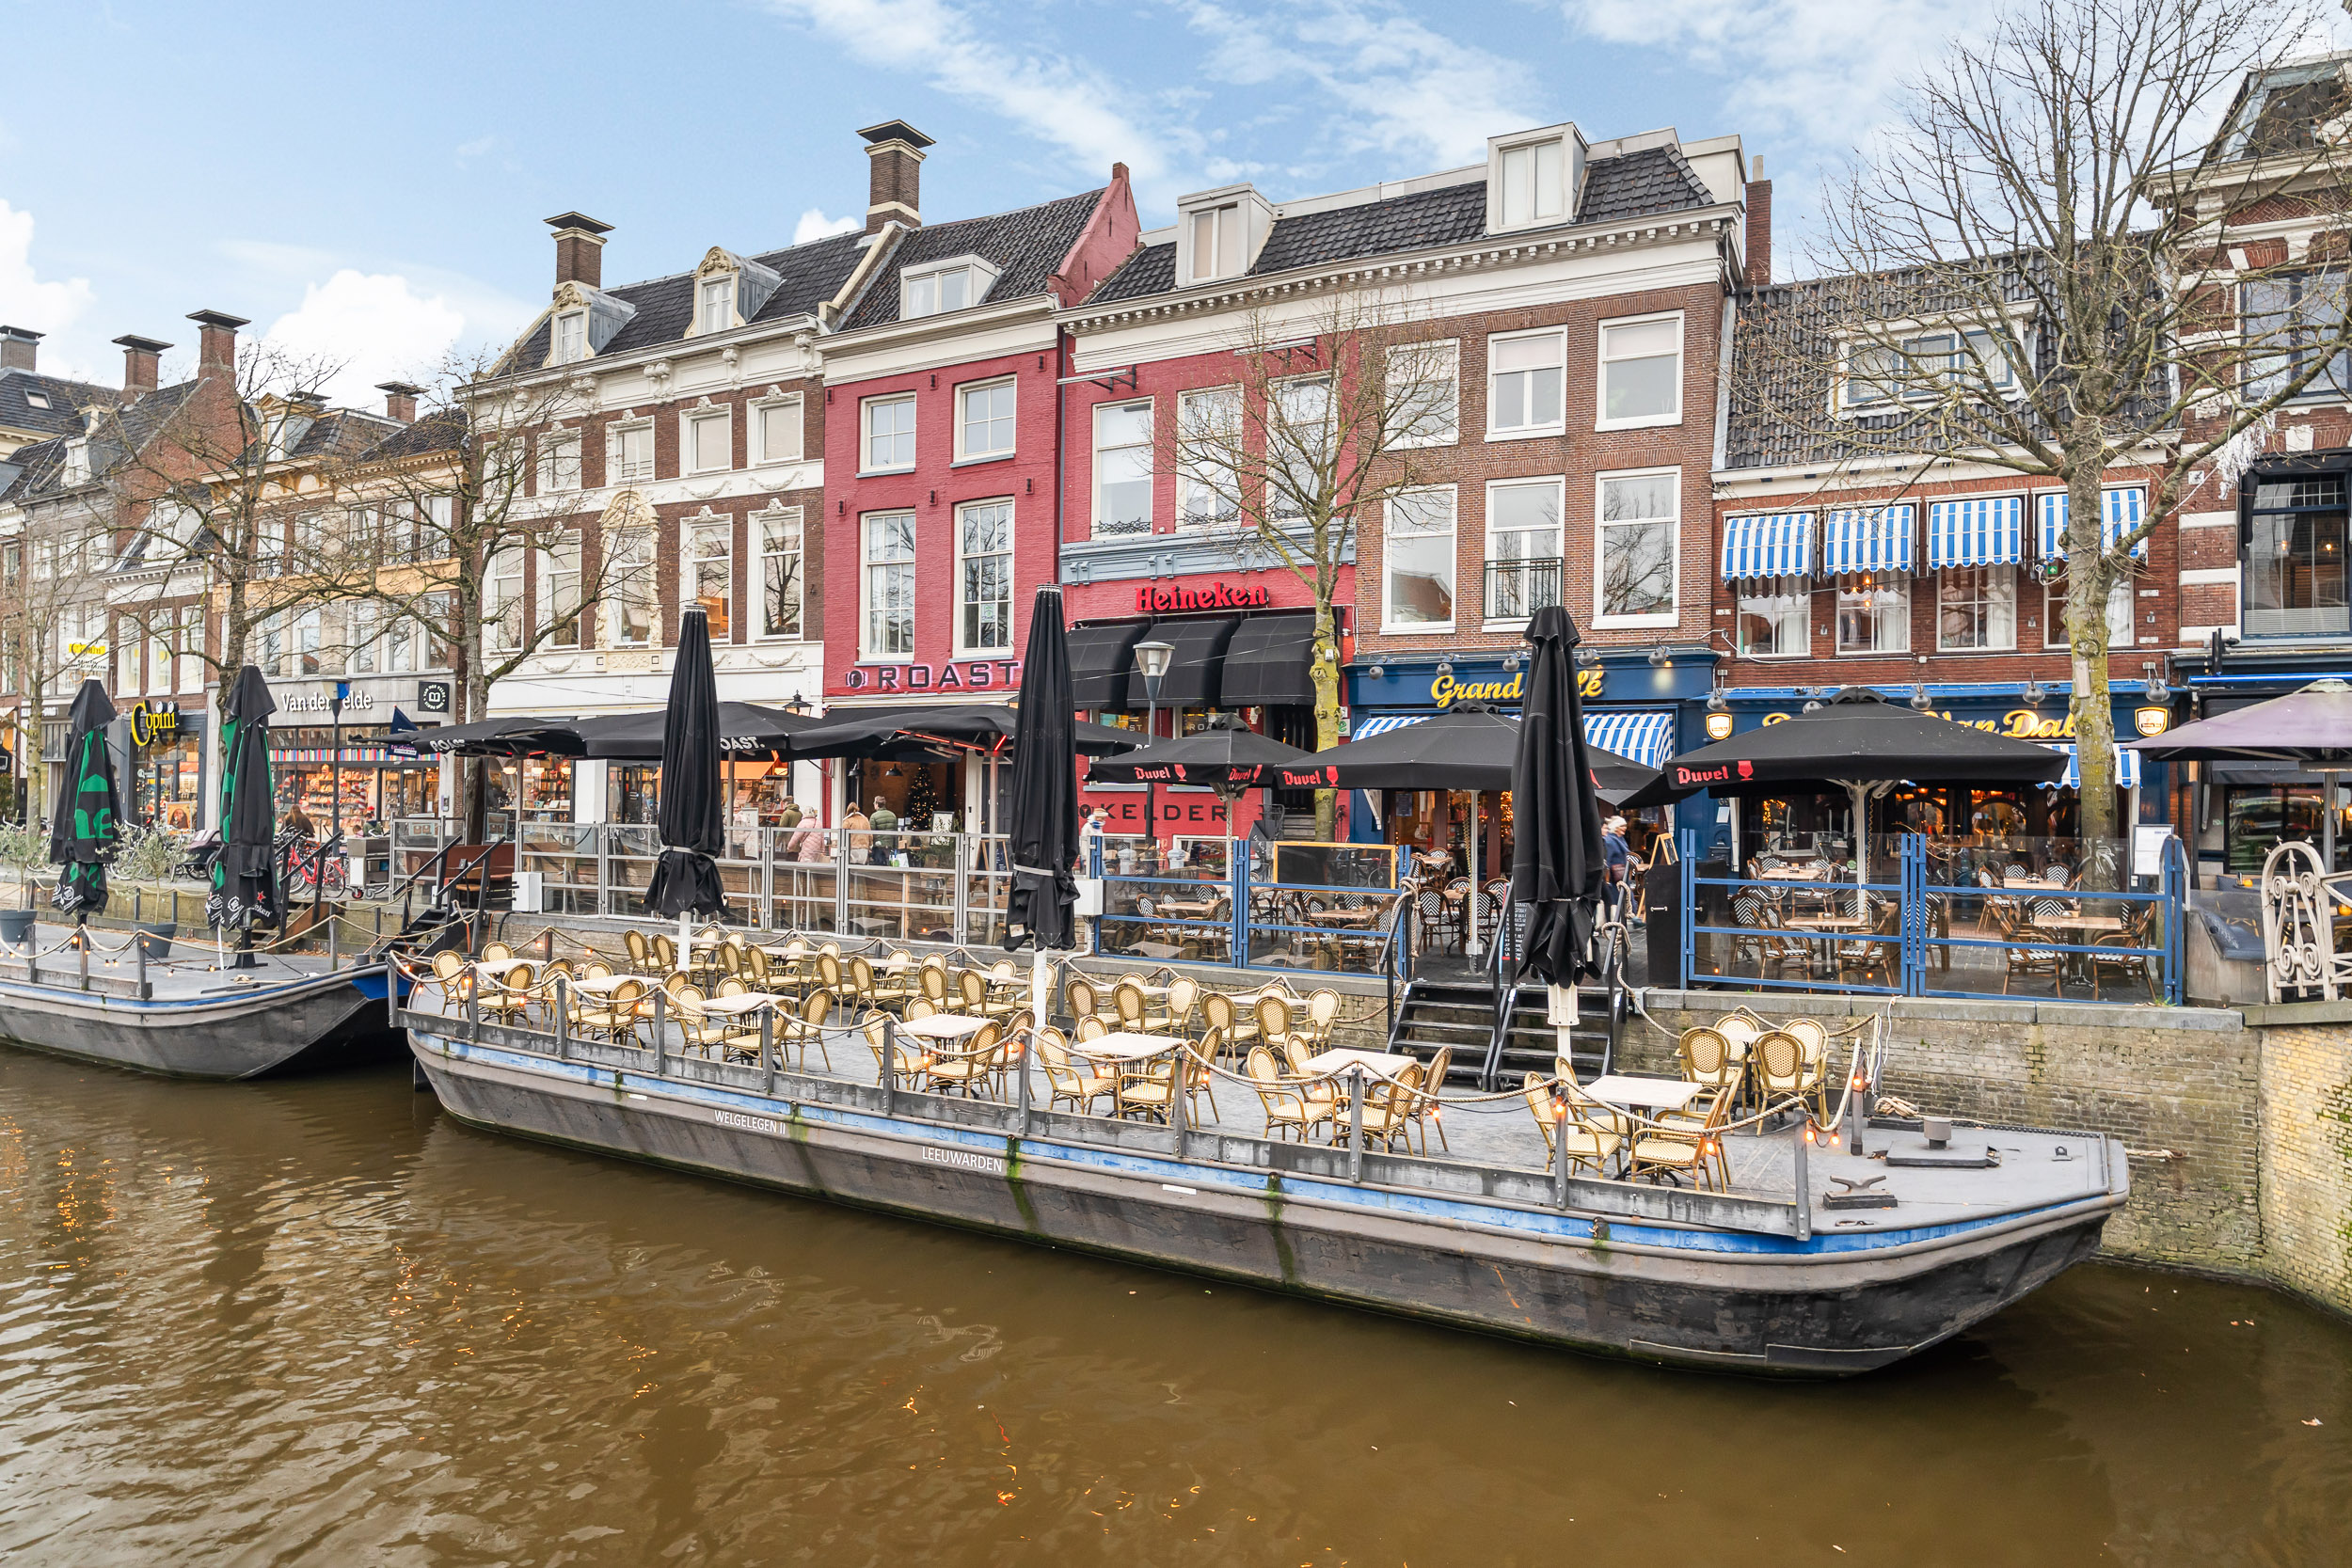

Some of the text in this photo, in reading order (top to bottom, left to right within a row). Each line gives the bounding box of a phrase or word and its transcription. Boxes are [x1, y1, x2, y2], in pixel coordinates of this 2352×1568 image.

[1135, 581, 1268, 611] Heineken
[879, 661, 1019, 689] ROAST
[280, 689, 373, 712] Van der elde
[1431, 673, 1524, 708] Grand
[131, 700, 176, 748] Copini
[2000, 709, 2076, 738] Dal
[720, 736, 766, 751] OAST.
[1134, 766, 1171, 781] Duvel
[1228, 768, 1252, 782] Duvel
[1282, 769, 1322, 785] Duvel
[1676, 765, 1729, 784] Duvel
[714, 1109, 787, 1135] WELGELEGEN II
[922, 1146, 1003, 1173] LEEUWARDEN
